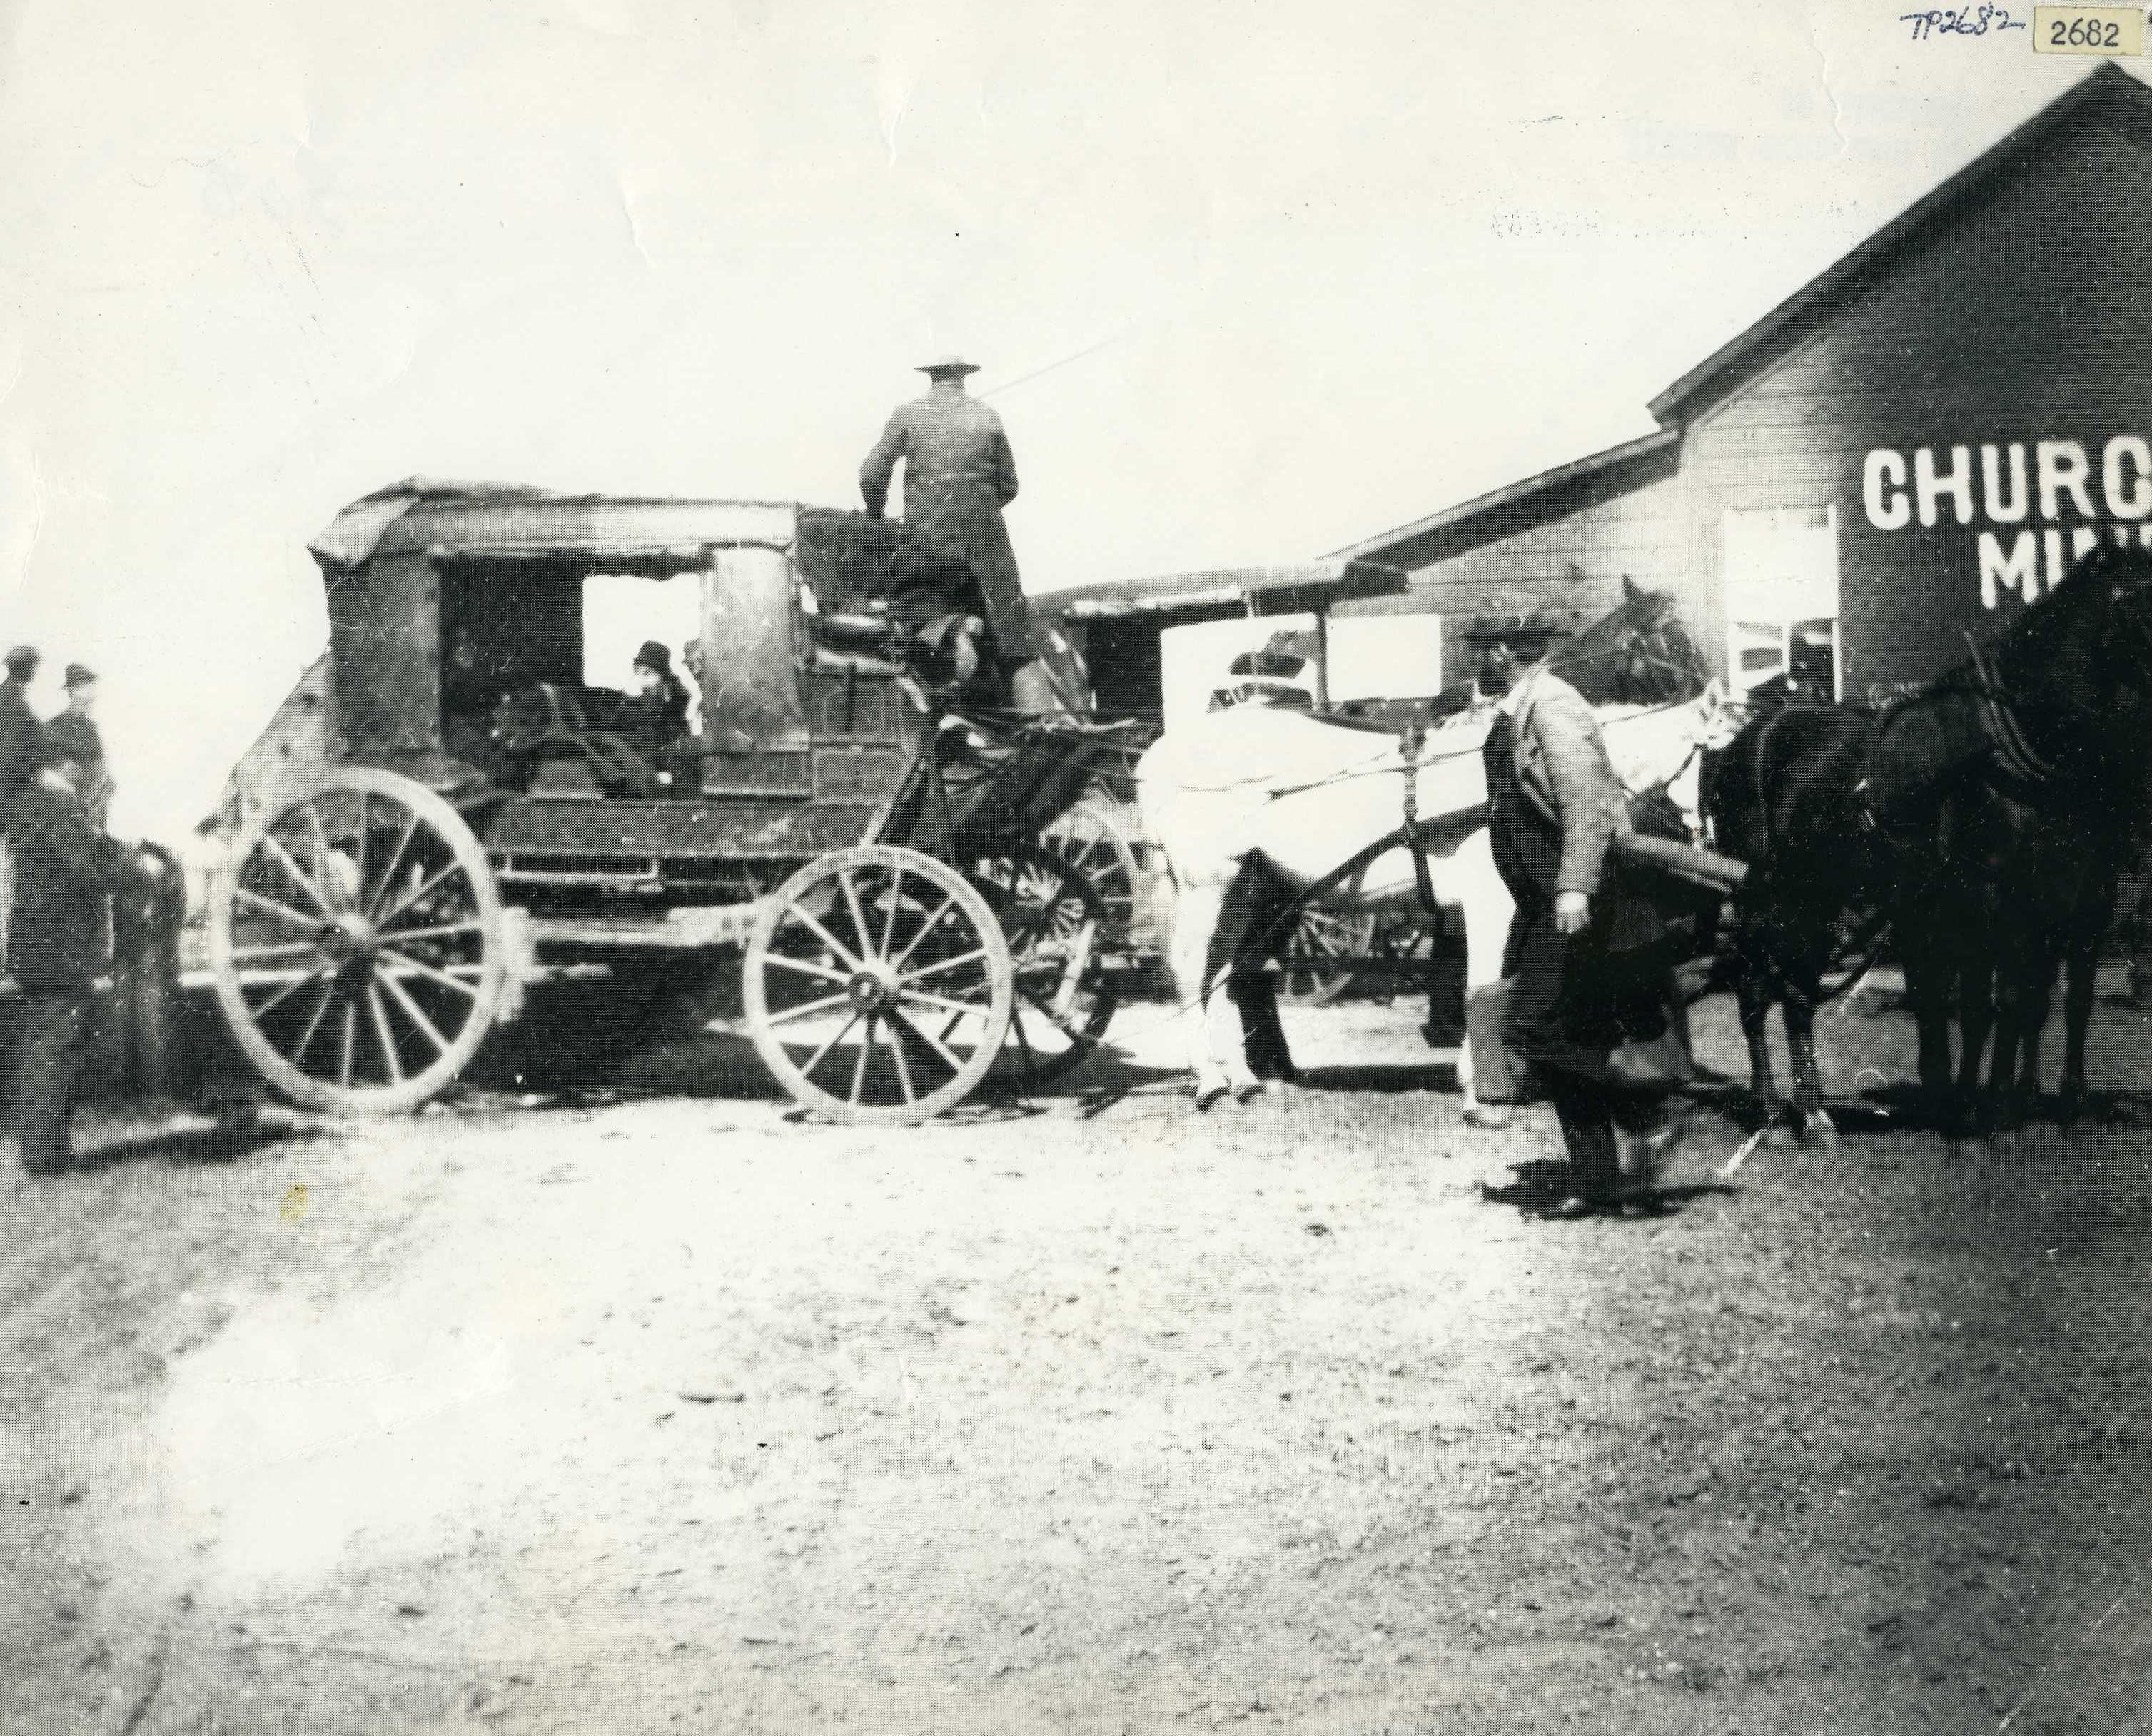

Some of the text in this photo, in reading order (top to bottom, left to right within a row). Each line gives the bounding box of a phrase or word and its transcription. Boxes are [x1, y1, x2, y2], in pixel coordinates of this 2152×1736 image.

[2050, 16, 2121, 47] 2682
[1864, 434, 2152, 530] CHURC
[1978, 525, 2152, 610] MI
